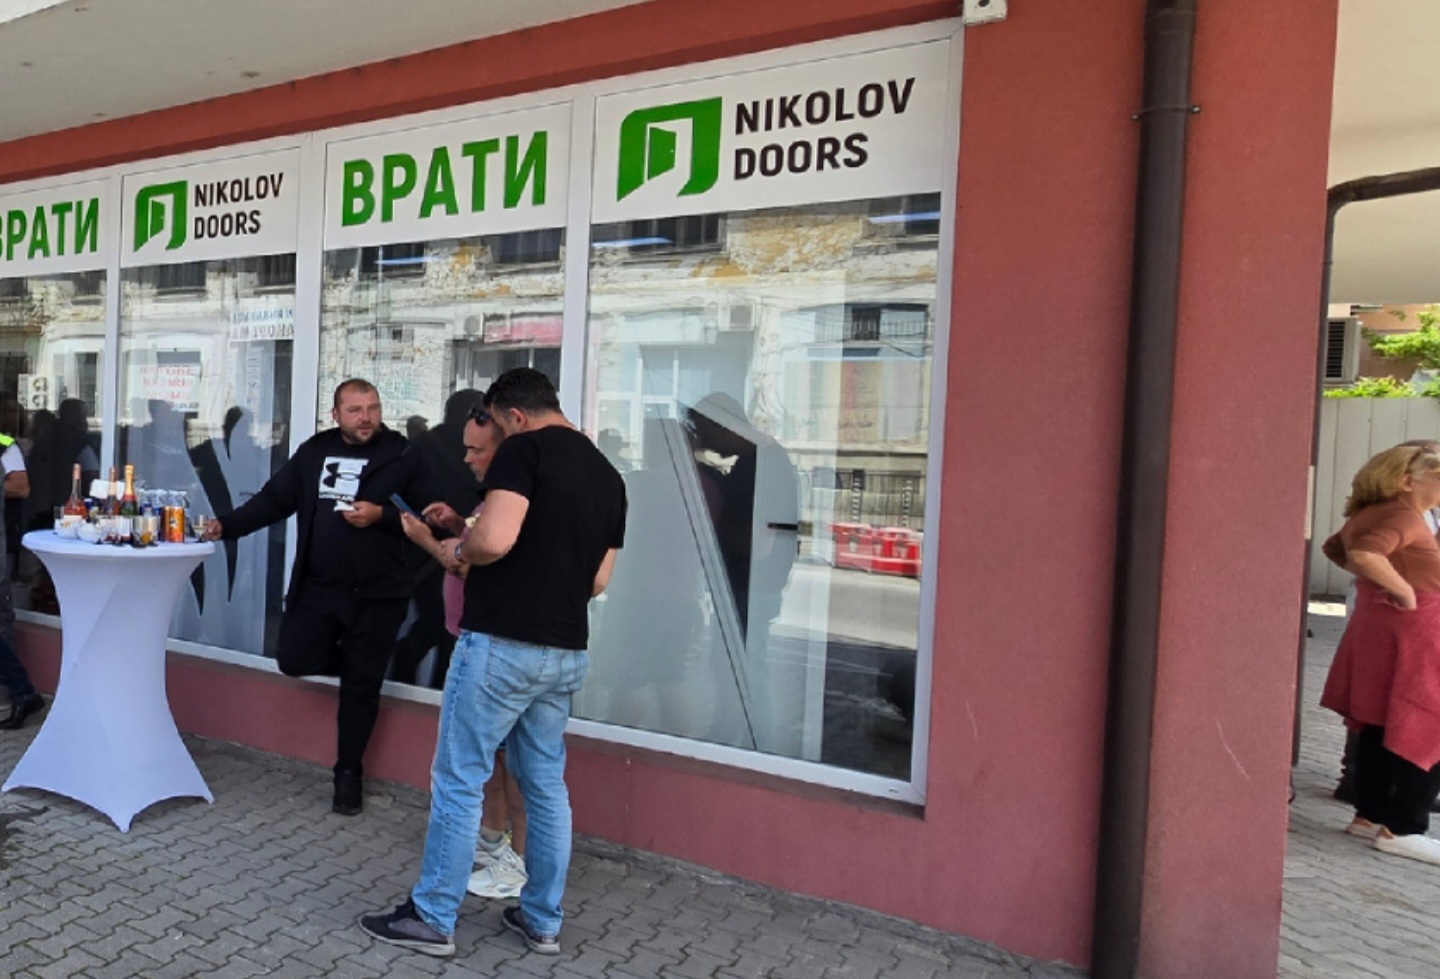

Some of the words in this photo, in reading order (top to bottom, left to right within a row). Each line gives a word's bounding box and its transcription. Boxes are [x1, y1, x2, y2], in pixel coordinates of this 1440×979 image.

[734, 77, 916, 136] NIKOLOV
[341, 130, 548, 227] ВРАТИ
[734, 133, 869, 181] DOORS
[194, 172, 284, 207] NIKOLOV
[194, 209, 262, 240] DOORS
